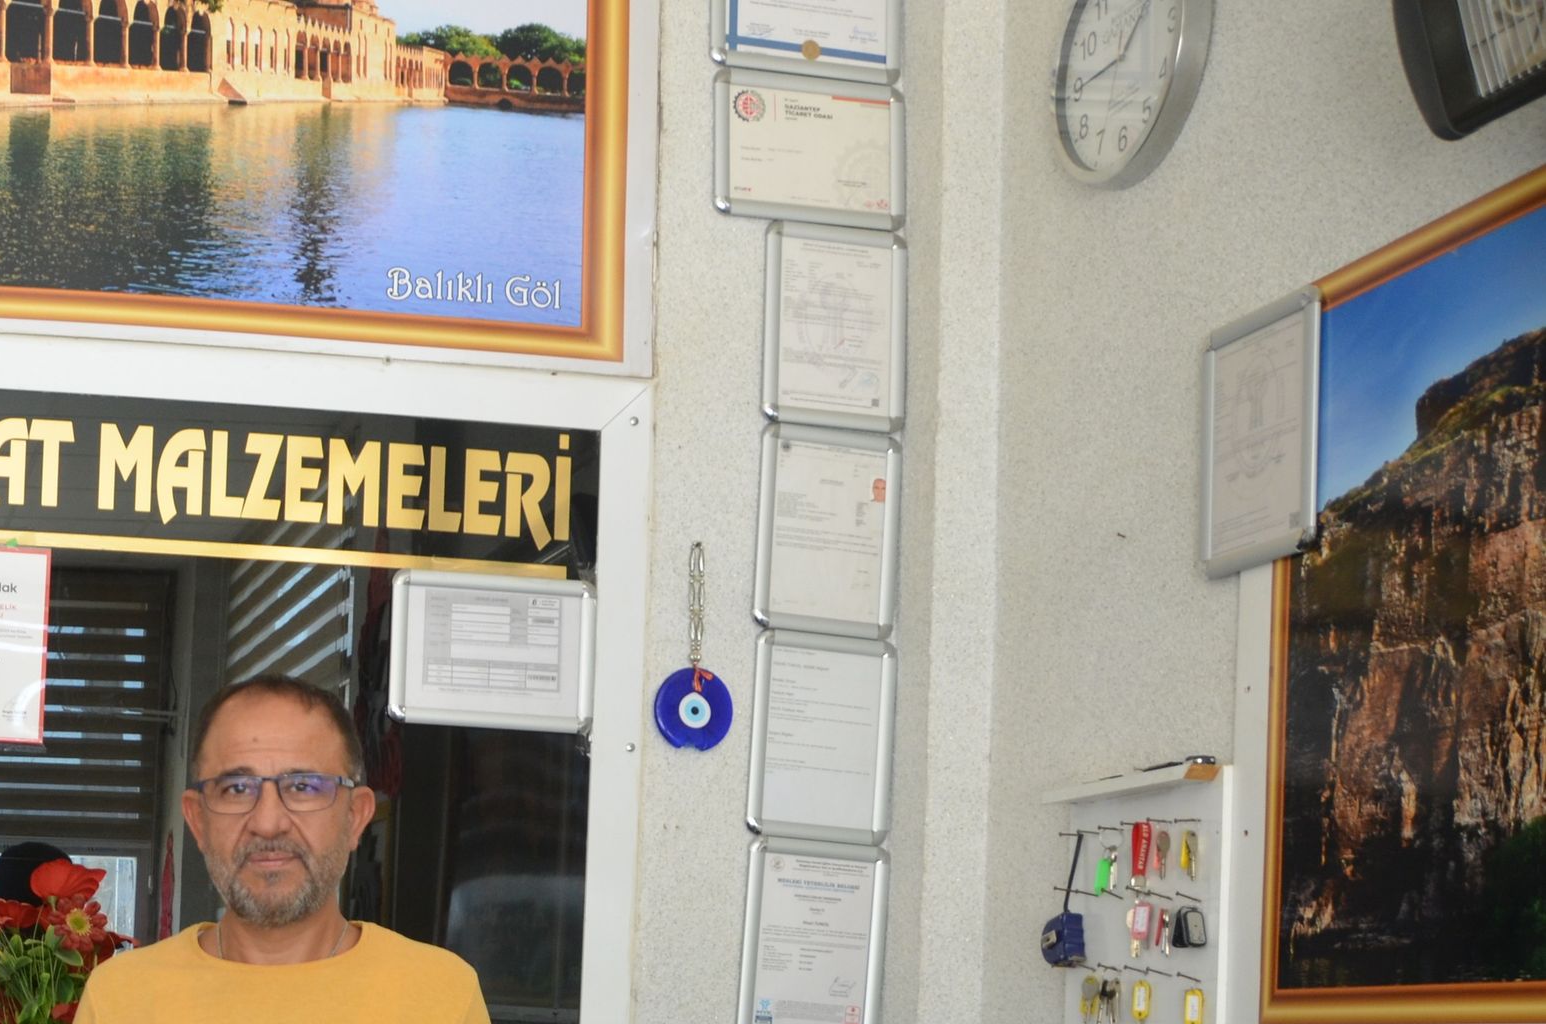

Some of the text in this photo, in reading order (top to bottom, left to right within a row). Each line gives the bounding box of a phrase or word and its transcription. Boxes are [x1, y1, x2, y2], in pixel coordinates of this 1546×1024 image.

[1080, 31, 1097, 60] 10
[1074, 77, 1083, 102] 9
[1142, 96, 1151, 124] 5
[1079, 114, 1089, 140] 8
[1118, 126, 1128, 151] 6
[1097, 129, 1105, 155] 7
[387, 267, 561, 310] Balıklı Göl
[97, 422, 571, 551] MALZEMELERİ
